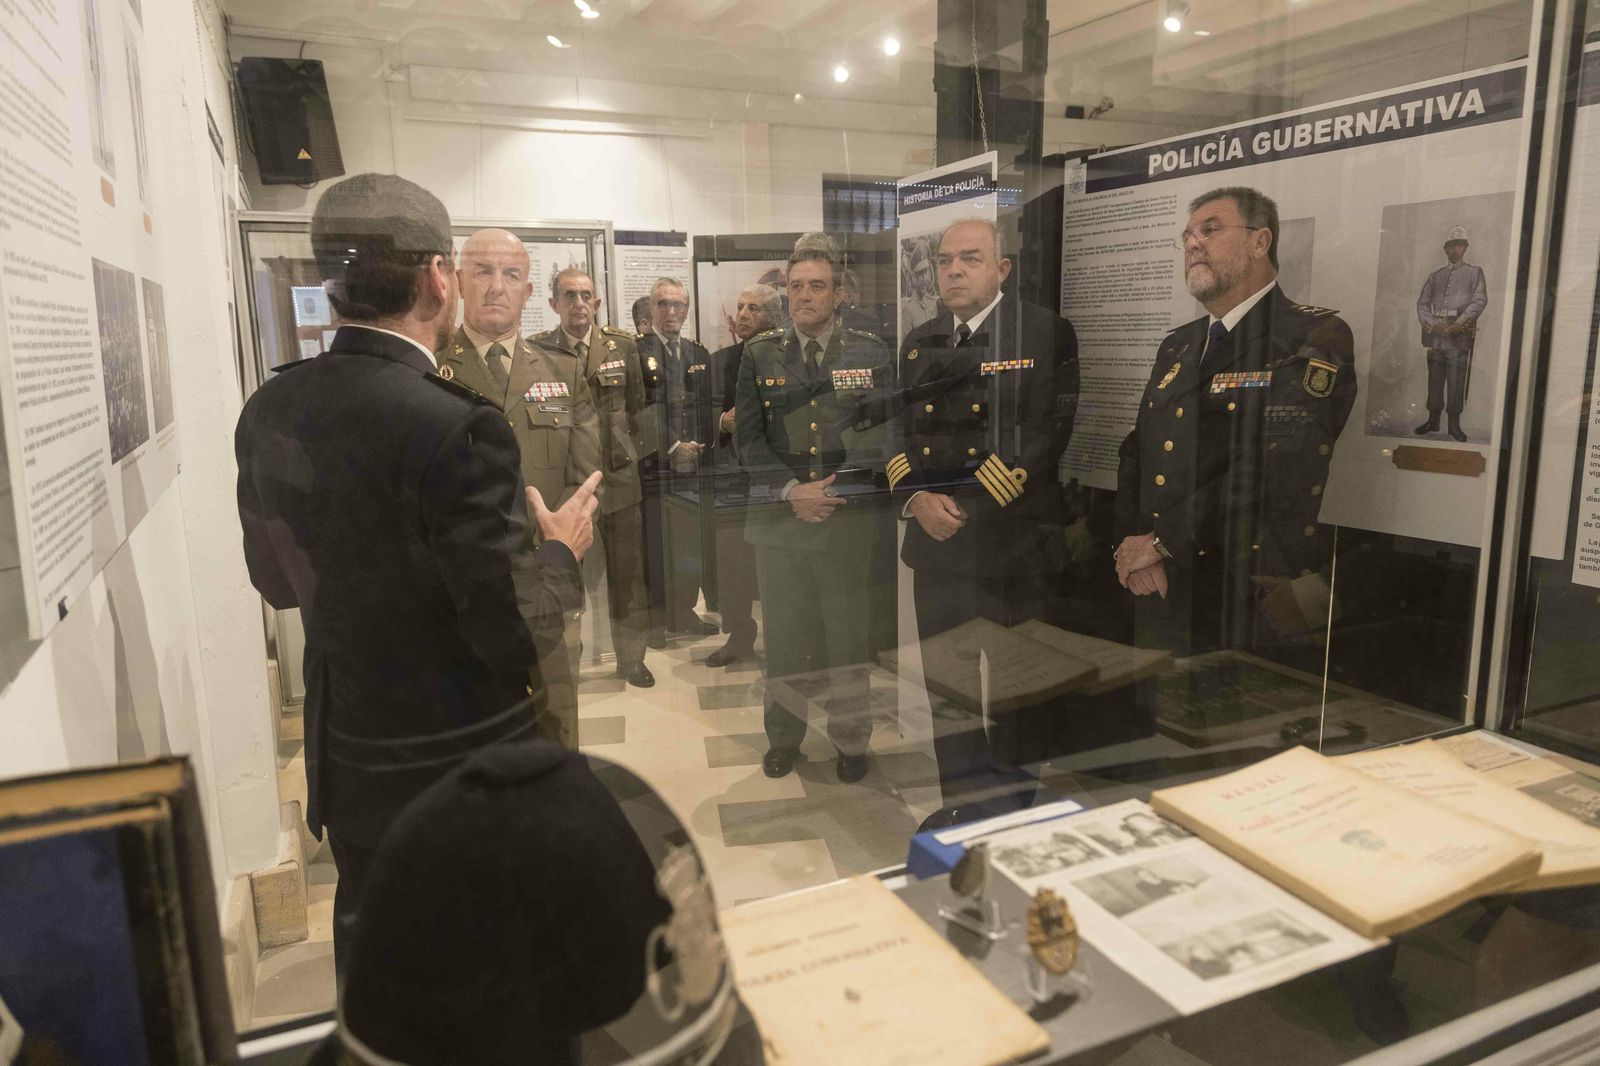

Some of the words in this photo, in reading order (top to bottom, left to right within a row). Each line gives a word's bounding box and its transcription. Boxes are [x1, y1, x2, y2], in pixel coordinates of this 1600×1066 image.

[1148, 134, 1244, 176] POLICÍA
[1252, 88, 1486, 156] GUBERNATIVA
[903, 191, 933, 206] HISTORIA
[934, 188, 943, 198] DE
[944, 185, 953, 195] LA
[955, 175, 985, 193] POLICÍA
